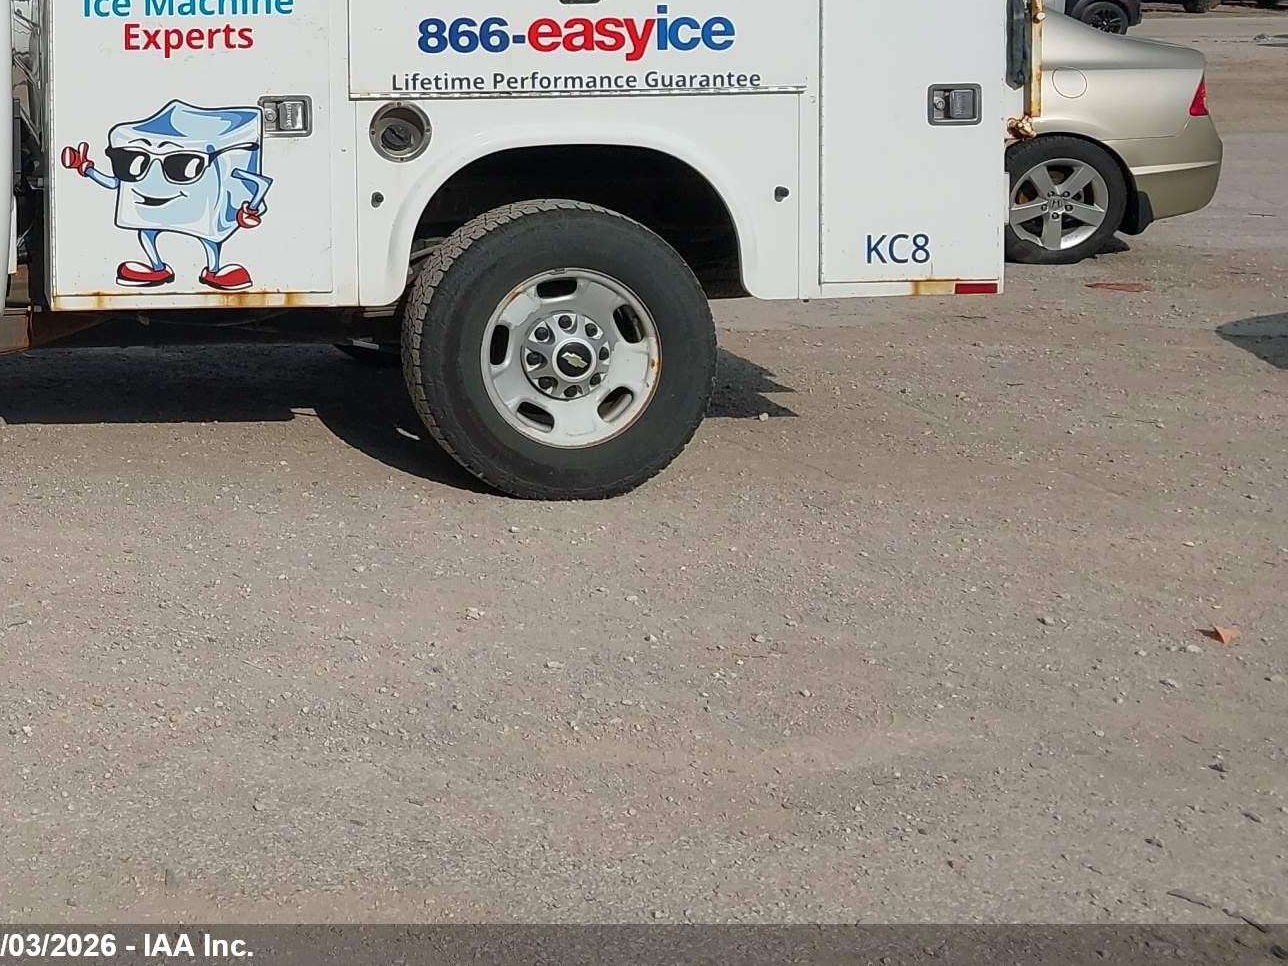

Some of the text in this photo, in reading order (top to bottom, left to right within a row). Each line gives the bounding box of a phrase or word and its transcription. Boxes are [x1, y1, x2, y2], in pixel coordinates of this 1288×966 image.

[123, 23, 254, 59] Experts
[391, 71, 761, 92] Lifetime Performance Guarantee
[866, 233, 931, 265] KC8
